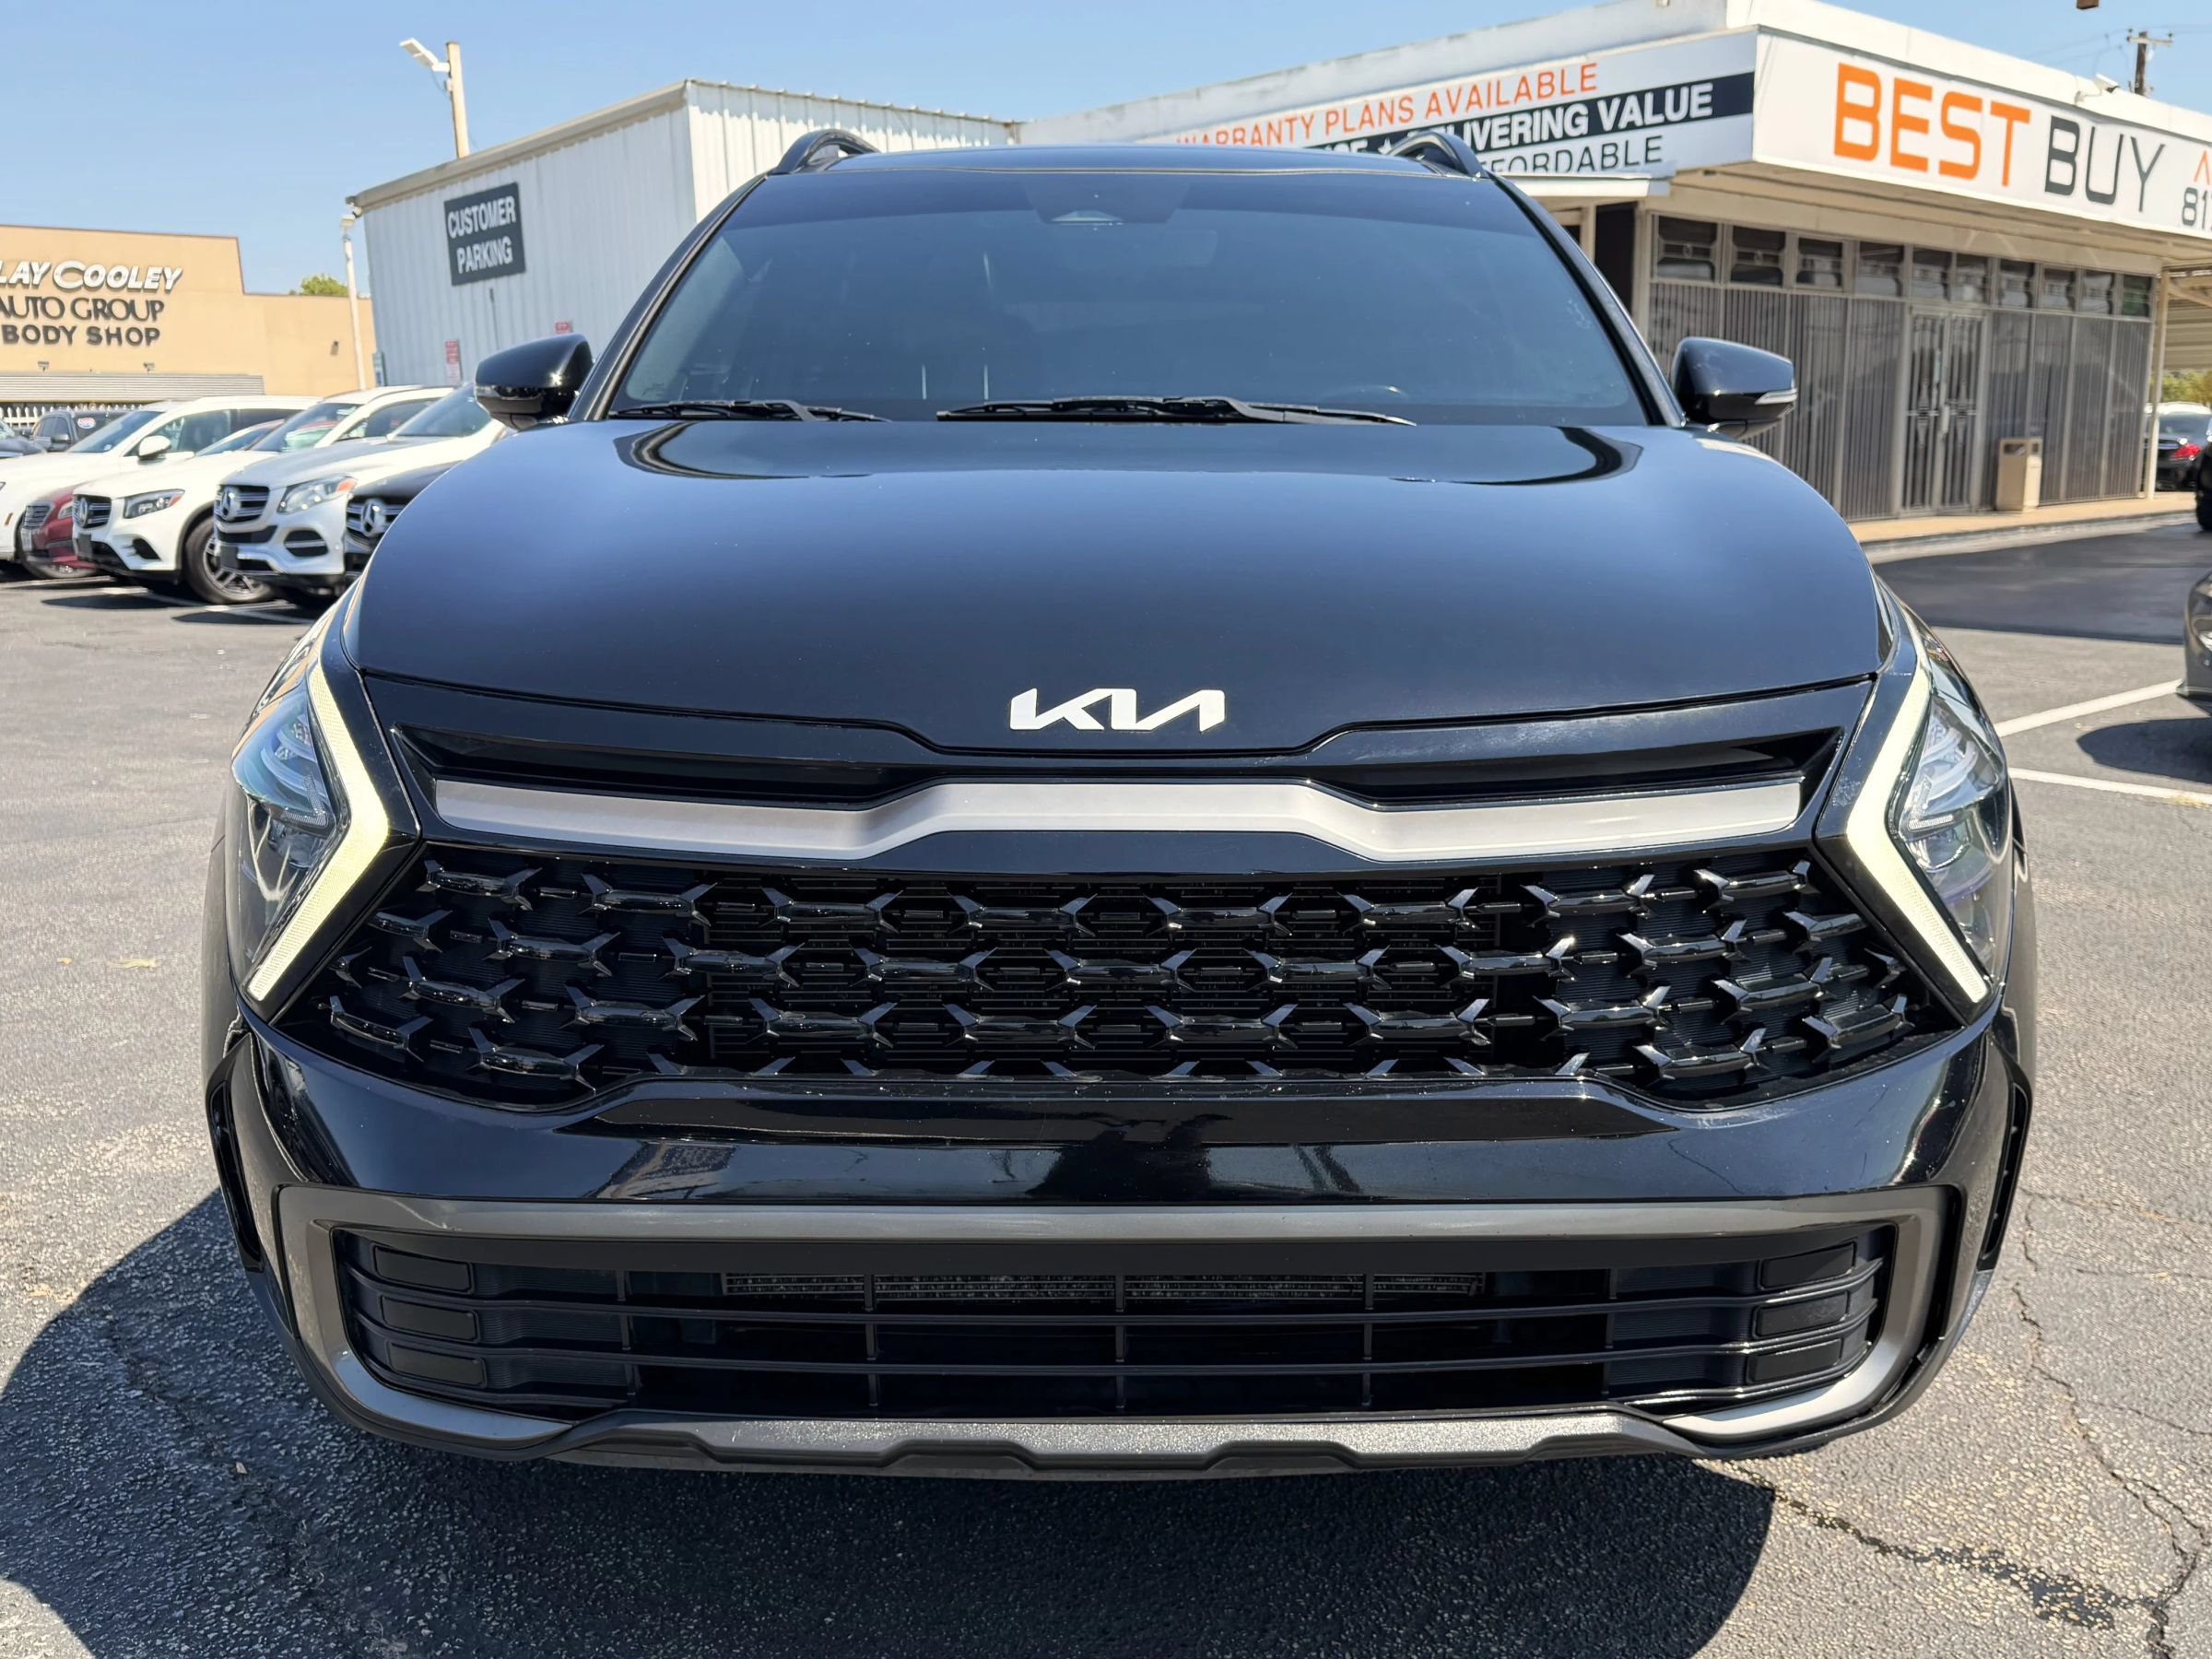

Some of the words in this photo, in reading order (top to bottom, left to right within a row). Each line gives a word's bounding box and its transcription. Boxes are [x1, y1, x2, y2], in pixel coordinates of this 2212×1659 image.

[1324, 96, 1415, 135] PLANS
[1425, 63, 1598, 120] AVAILABLE
[1407, 102, 1589, 151] IVERING
[1596, 83, 1713, 132] VALUE
[1482, 135, 1663, 173] FORDABLE
[1834, 63, 2031, 187] BEST
[2044, 115, 2166, 213] BUY
[447, 196, 516, 239] CUSTOMER
[2182, 187, 2212, 229] 81
[53, 260, 183, 292] COOLEY
[456, 236, 513, 274] PARKING
[70, 297, 165, 323] GROUP
[2, 324, 77, 347] BODY
[86, 325, 160, 347] SHOP
[1010, 688, 1226, 733] KIA
